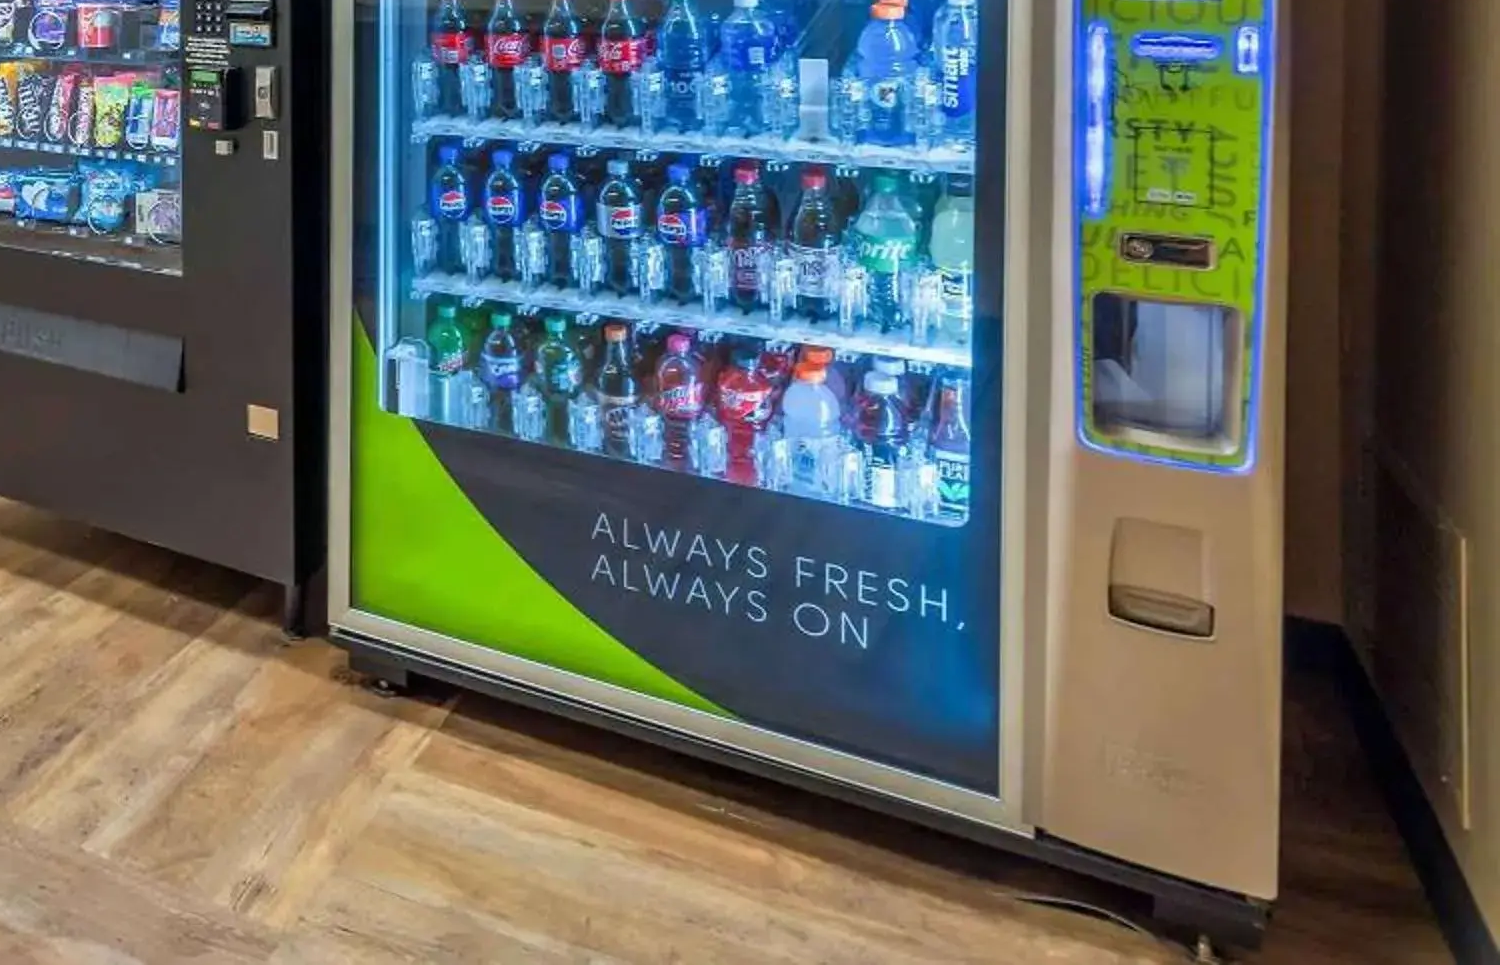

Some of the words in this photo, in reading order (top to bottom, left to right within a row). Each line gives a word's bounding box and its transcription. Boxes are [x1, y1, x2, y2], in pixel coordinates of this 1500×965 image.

[943, 48, 959, 108] smart
[856, 241, 911, 260] prite
[591, 512, 768, 579] ALWAYS
[795, 556, 966, 631] FRESH,
[591, 554, 768, 622] ALWAYS
[793, 602, 869, 649] ON
